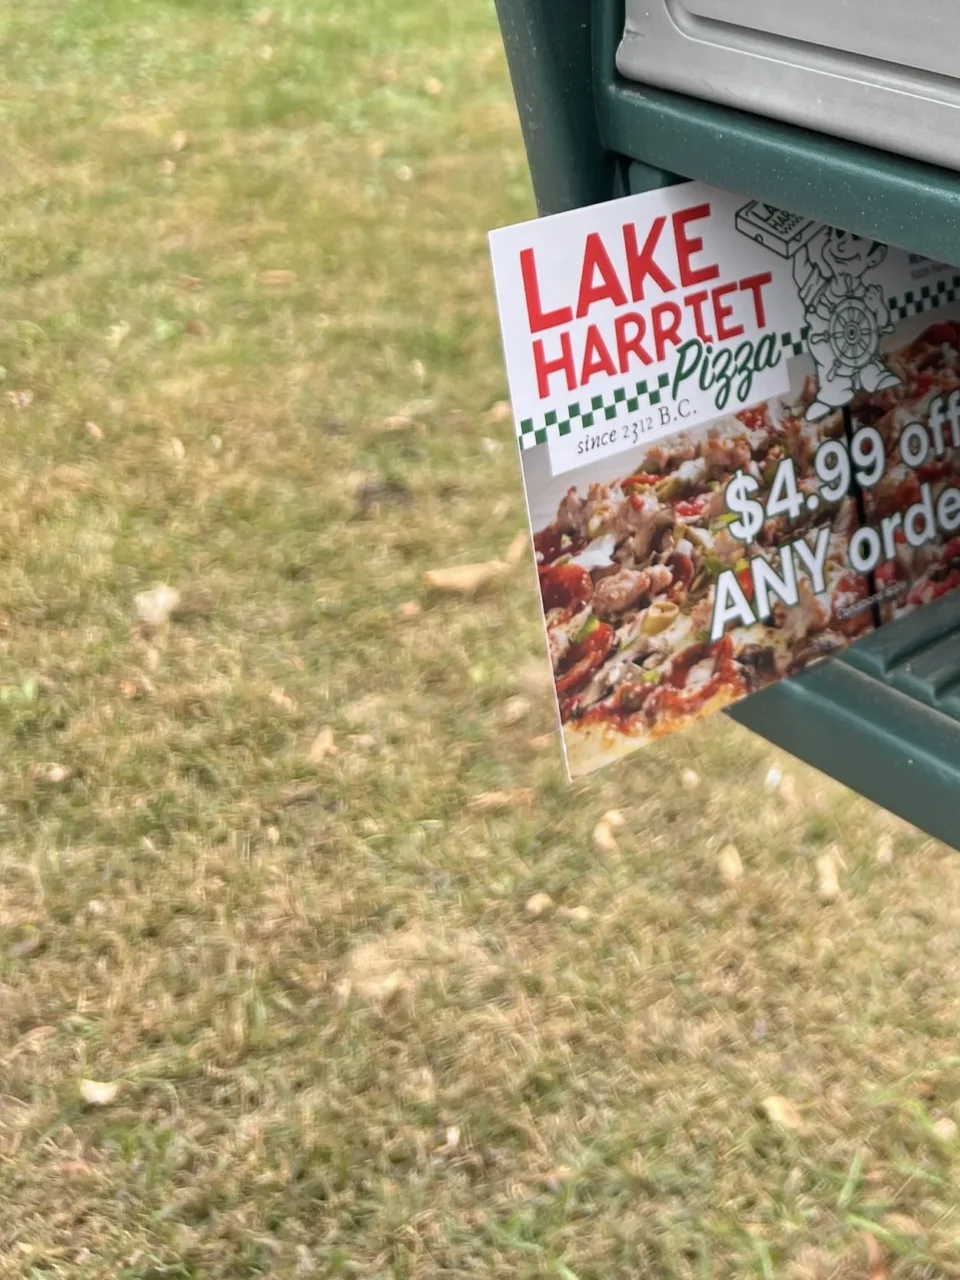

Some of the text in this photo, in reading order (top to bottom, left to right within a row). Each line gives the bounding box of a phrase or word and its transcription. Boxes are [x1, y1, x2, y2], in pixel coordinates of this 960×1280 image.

[520, 203, 720, 334] LAKE
[532, 272, 773, 400] HARRIET
[671, 331, 782, 410] Pizza
[577, 398, 697, 454] since 2312 B.C.
[725, 426, 884, 544] $4.99
[710, 528, 831, 643] ANY
